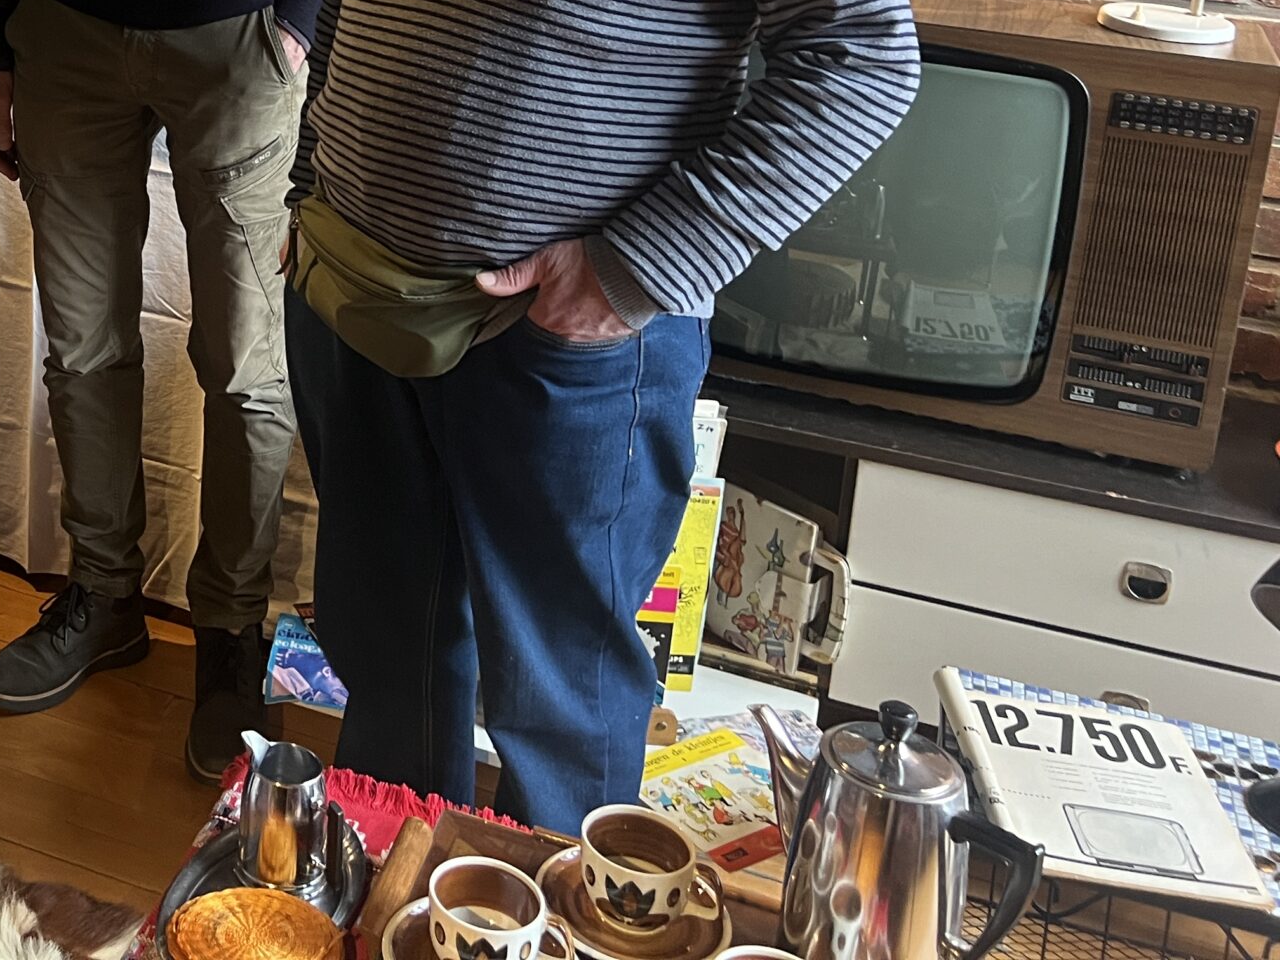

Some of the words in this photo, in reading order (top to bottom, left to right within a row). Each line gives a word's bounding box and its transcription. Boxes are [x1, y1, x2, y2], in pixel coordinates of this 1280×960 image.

[672, 748, 684, 756] de
[970, 700, 1166, 769] 12.750
[1168, 755, 1193, 775] F.
